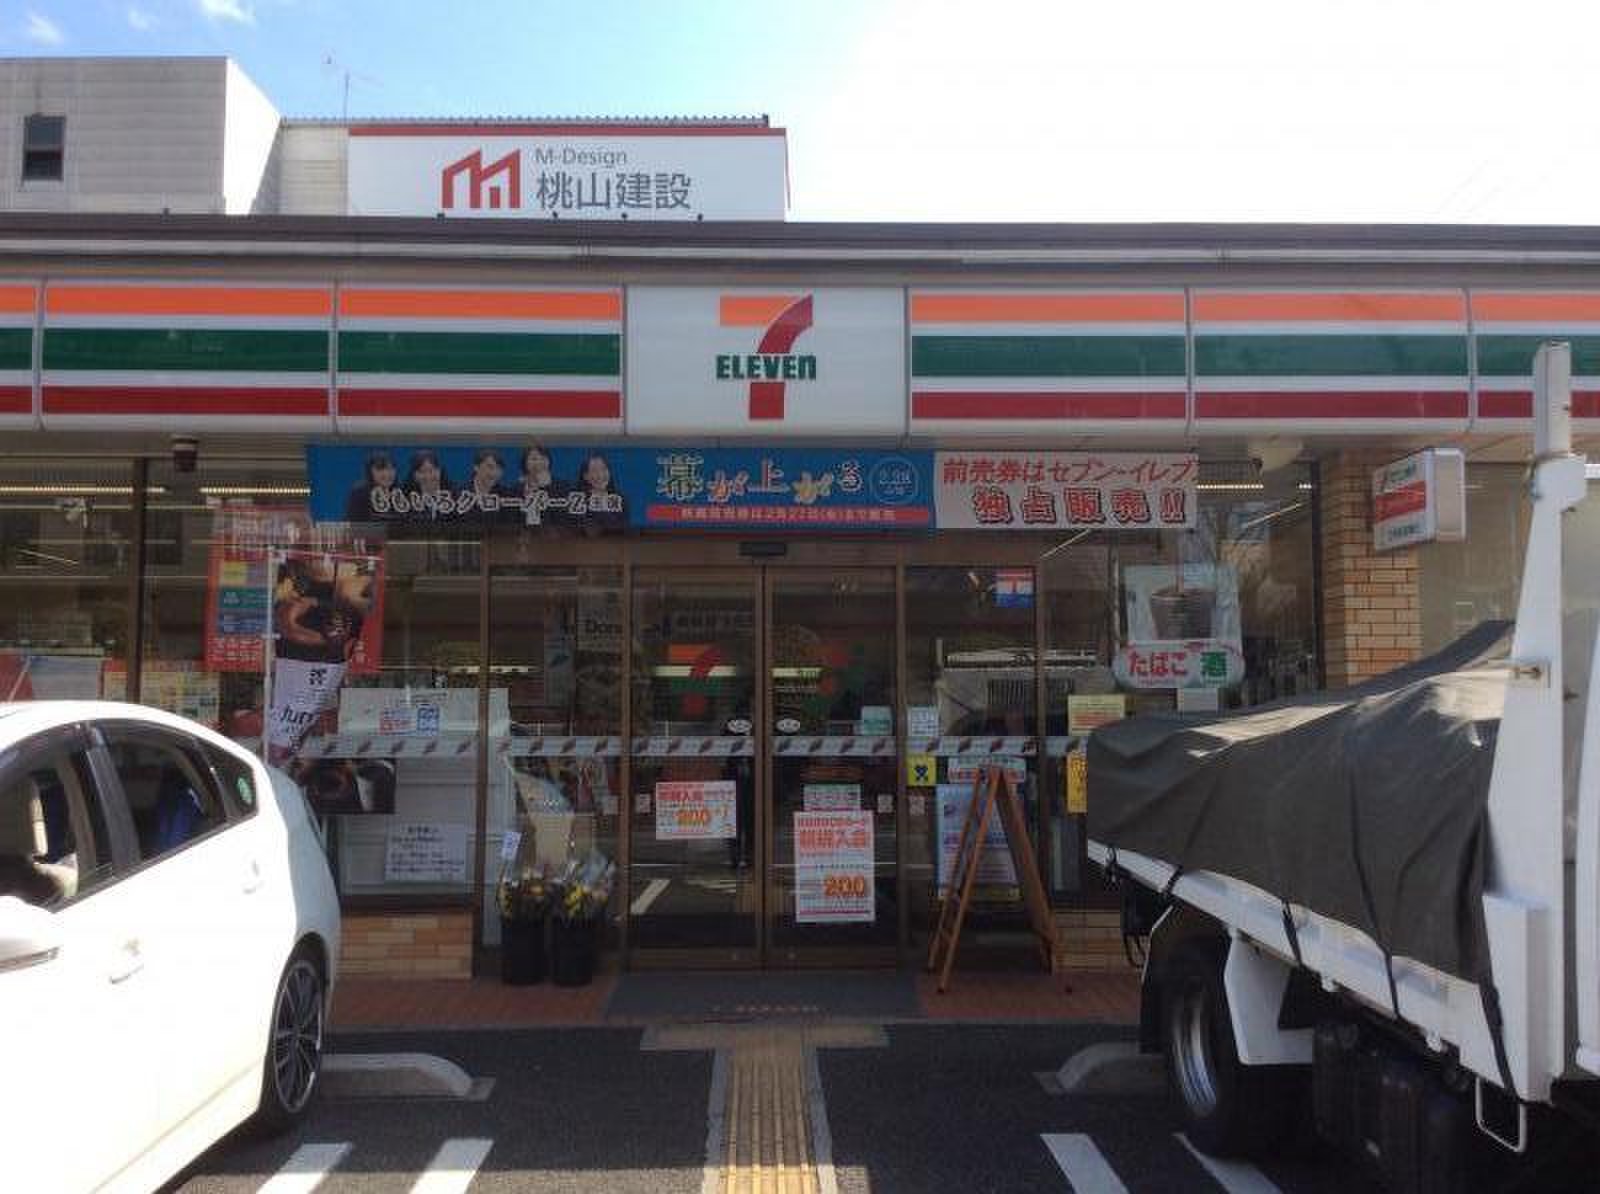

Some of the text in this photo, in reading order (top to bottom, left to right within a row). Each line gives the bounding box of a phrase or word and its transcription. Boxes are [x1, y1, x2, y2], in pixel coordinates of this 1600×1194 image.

[535, 147, 628, 168] M-Design
[536, 170, 692, 210] 桃山建設
[656, 450, 865, 504] 幕が上がる
[1127, 651, 1188, 677] たばこ
